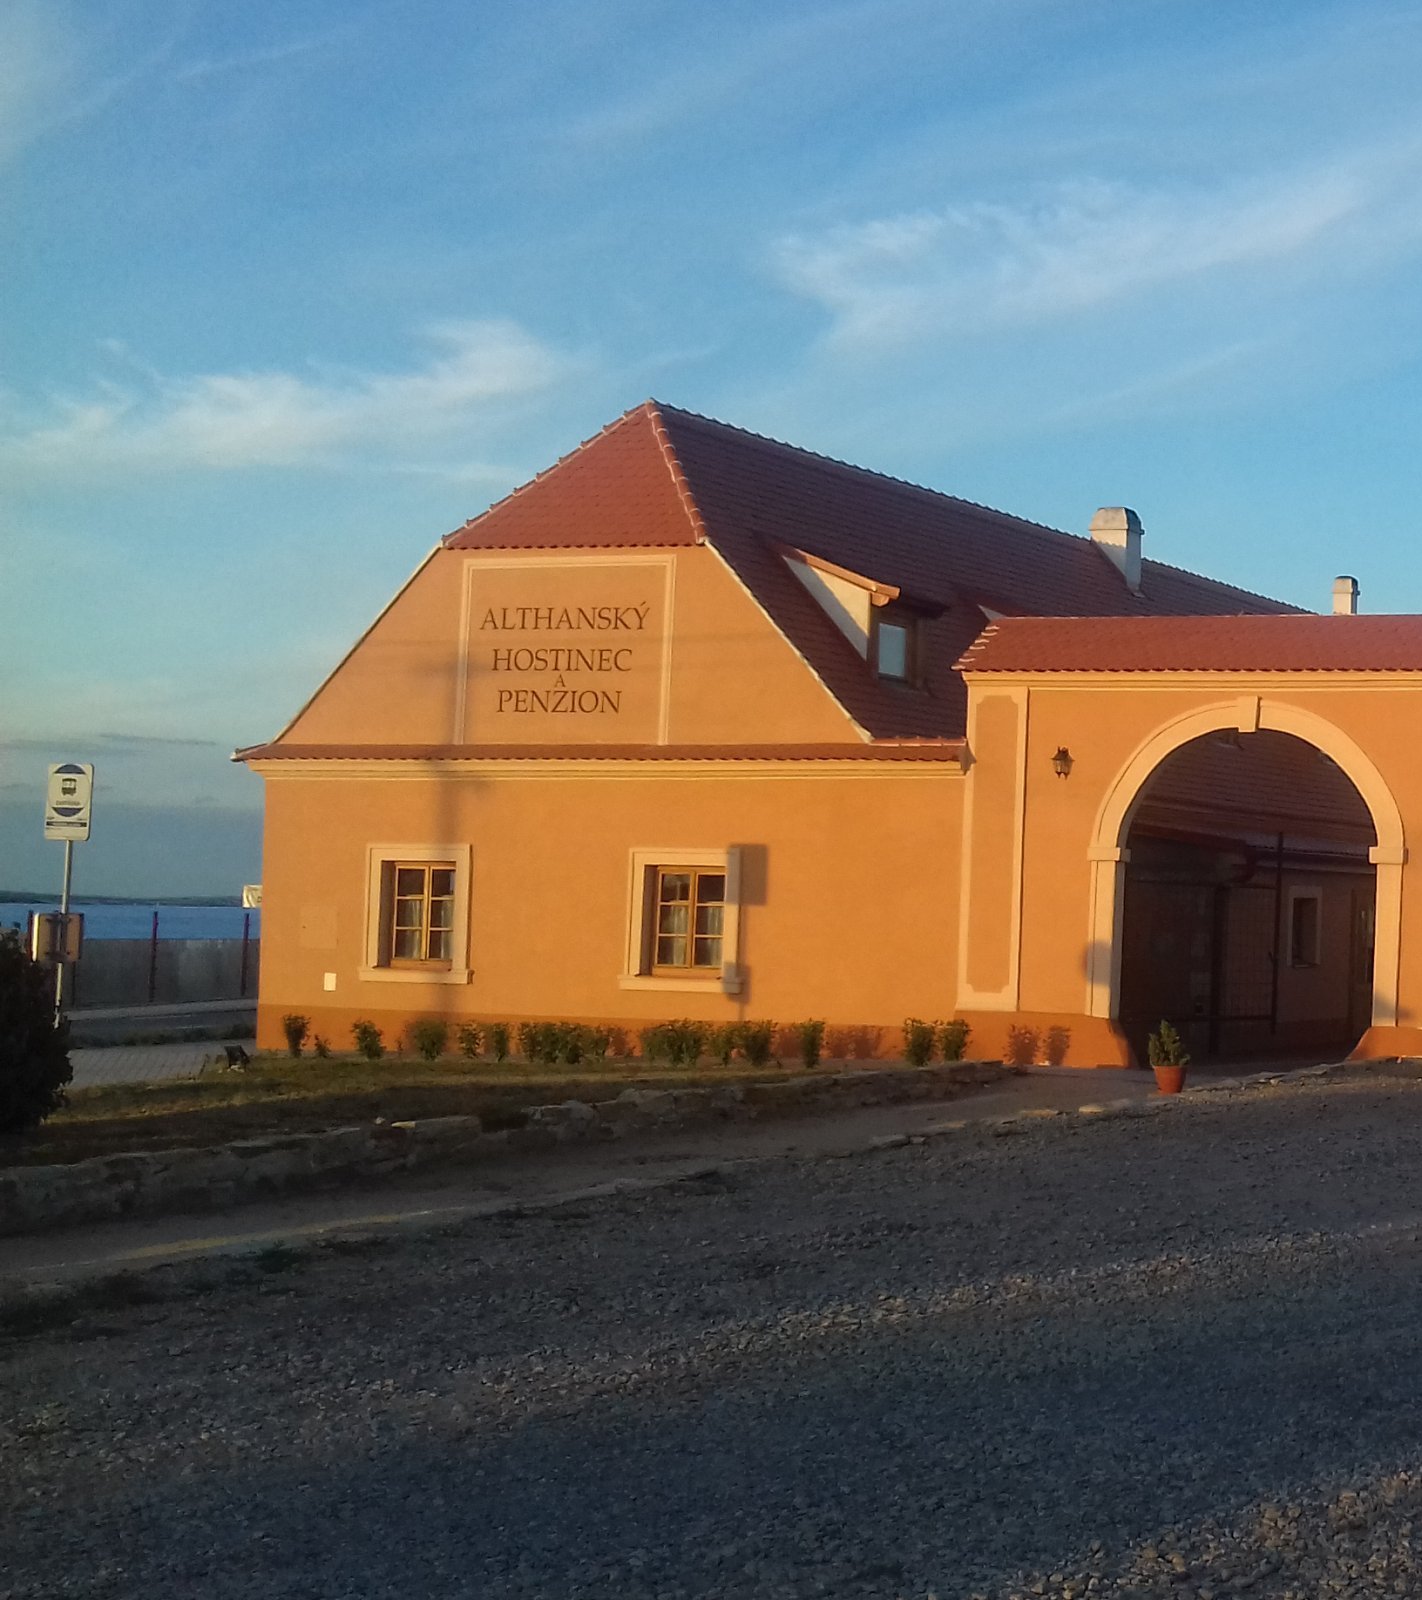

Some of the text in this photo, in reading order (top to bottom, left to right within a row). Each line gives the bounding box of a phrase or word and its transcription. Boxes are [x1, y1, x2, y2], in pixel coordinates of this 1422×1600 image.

[480, 601, 650, 630] ALTHANSKÝ
[491, 648, 633, 672] HOSTINEC
[554, 674, 566, 688] A
[496, 689, 623, 714] PENZION
